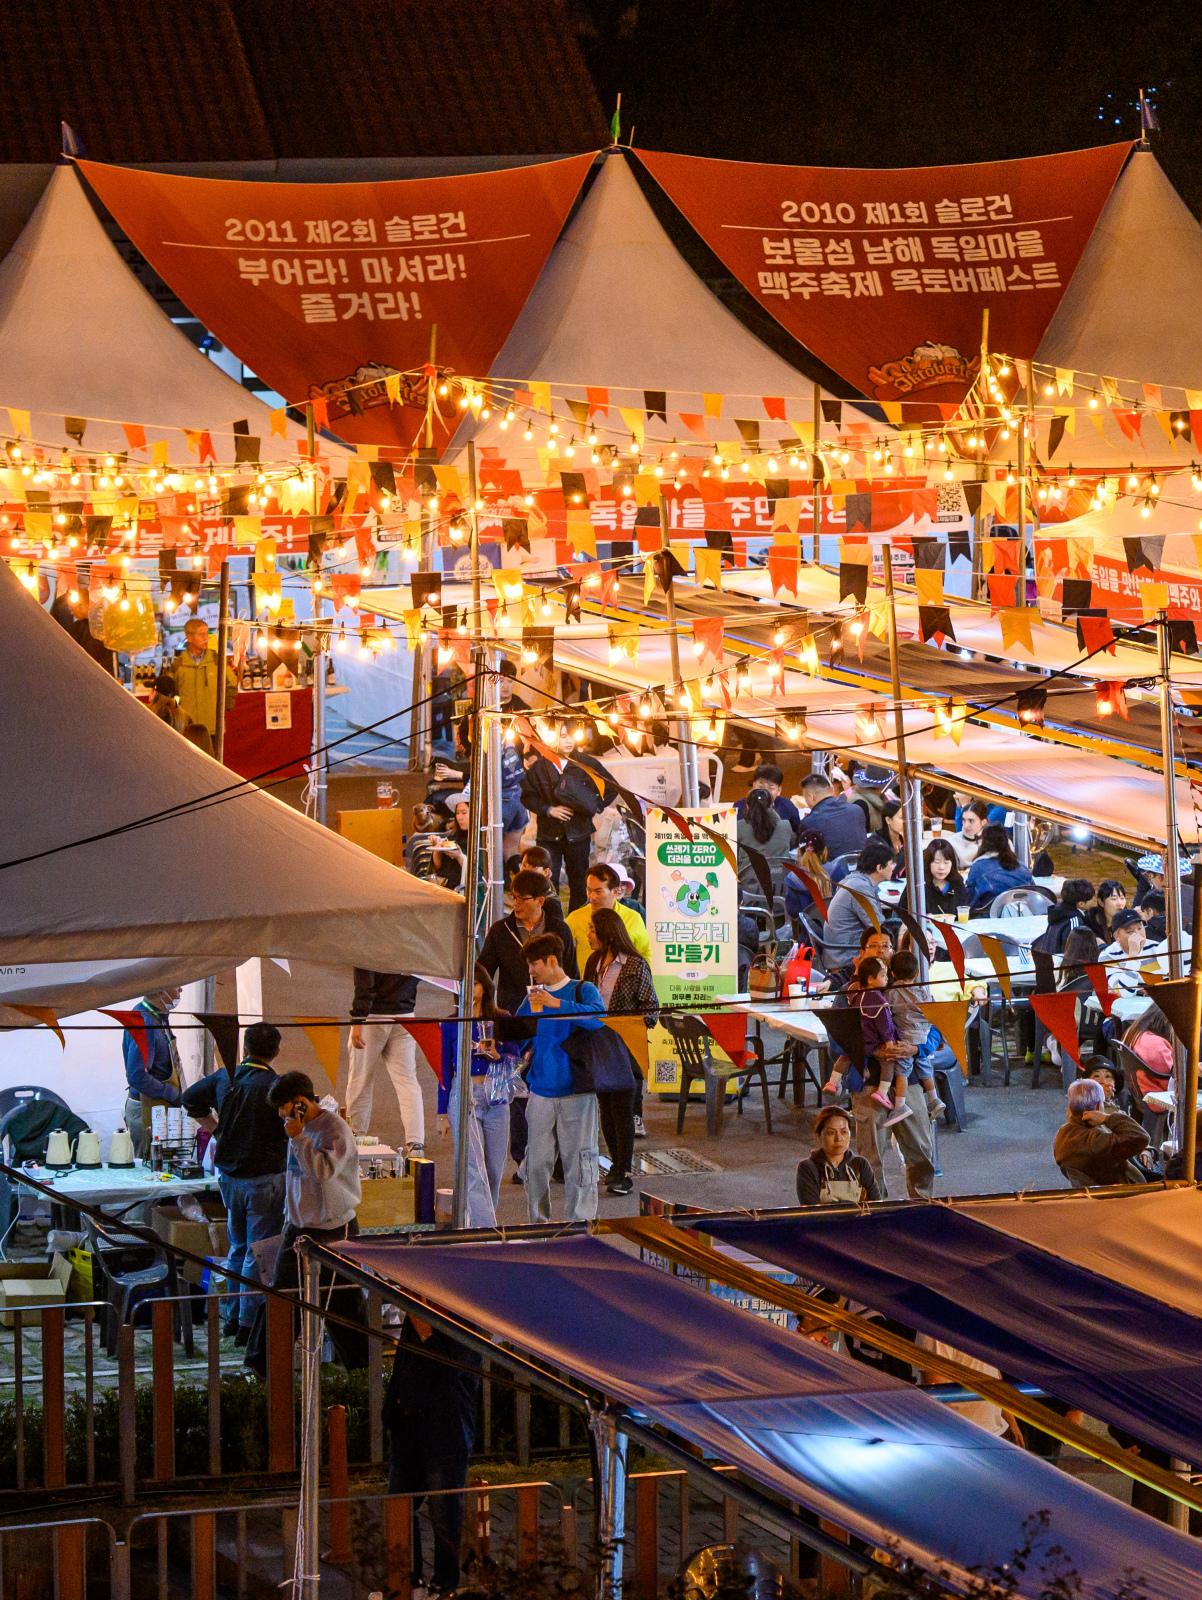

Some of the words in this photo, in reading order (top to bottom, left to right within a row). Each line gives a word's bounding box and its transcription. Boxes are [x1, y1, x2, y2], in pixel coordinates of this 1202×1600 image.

[781, 200, 856, 224] 2010
[862, 201, 929, 225] 제1회
[934, 194, 1014, 224] 슬로건
[224, 218, 299, 243] 2011
[304, 219, 377, 244] 제2회
[384, 211, 468, 243] 슬로건
[762, 236, 855, 266] 보물섬
[862, 236, 925, 265] 남해
[931, 230, 1045, 263] 독일마을
[238, 257, 349, 286] 부어라!
[361, 253, 467, 285] 마셔라!
[757, 271, 884, 300] 맥주축제
[890, 262, 1062, 294] 옥토버페스트
[300, 291, 422, 323] 즐겨라!
[666, 844, 690, 854] 쓰레기
[692, 845, 717, 854] ZERO
[693, 855, 716, 864] OUT!
[665, 944, 720, 963] 만들기
